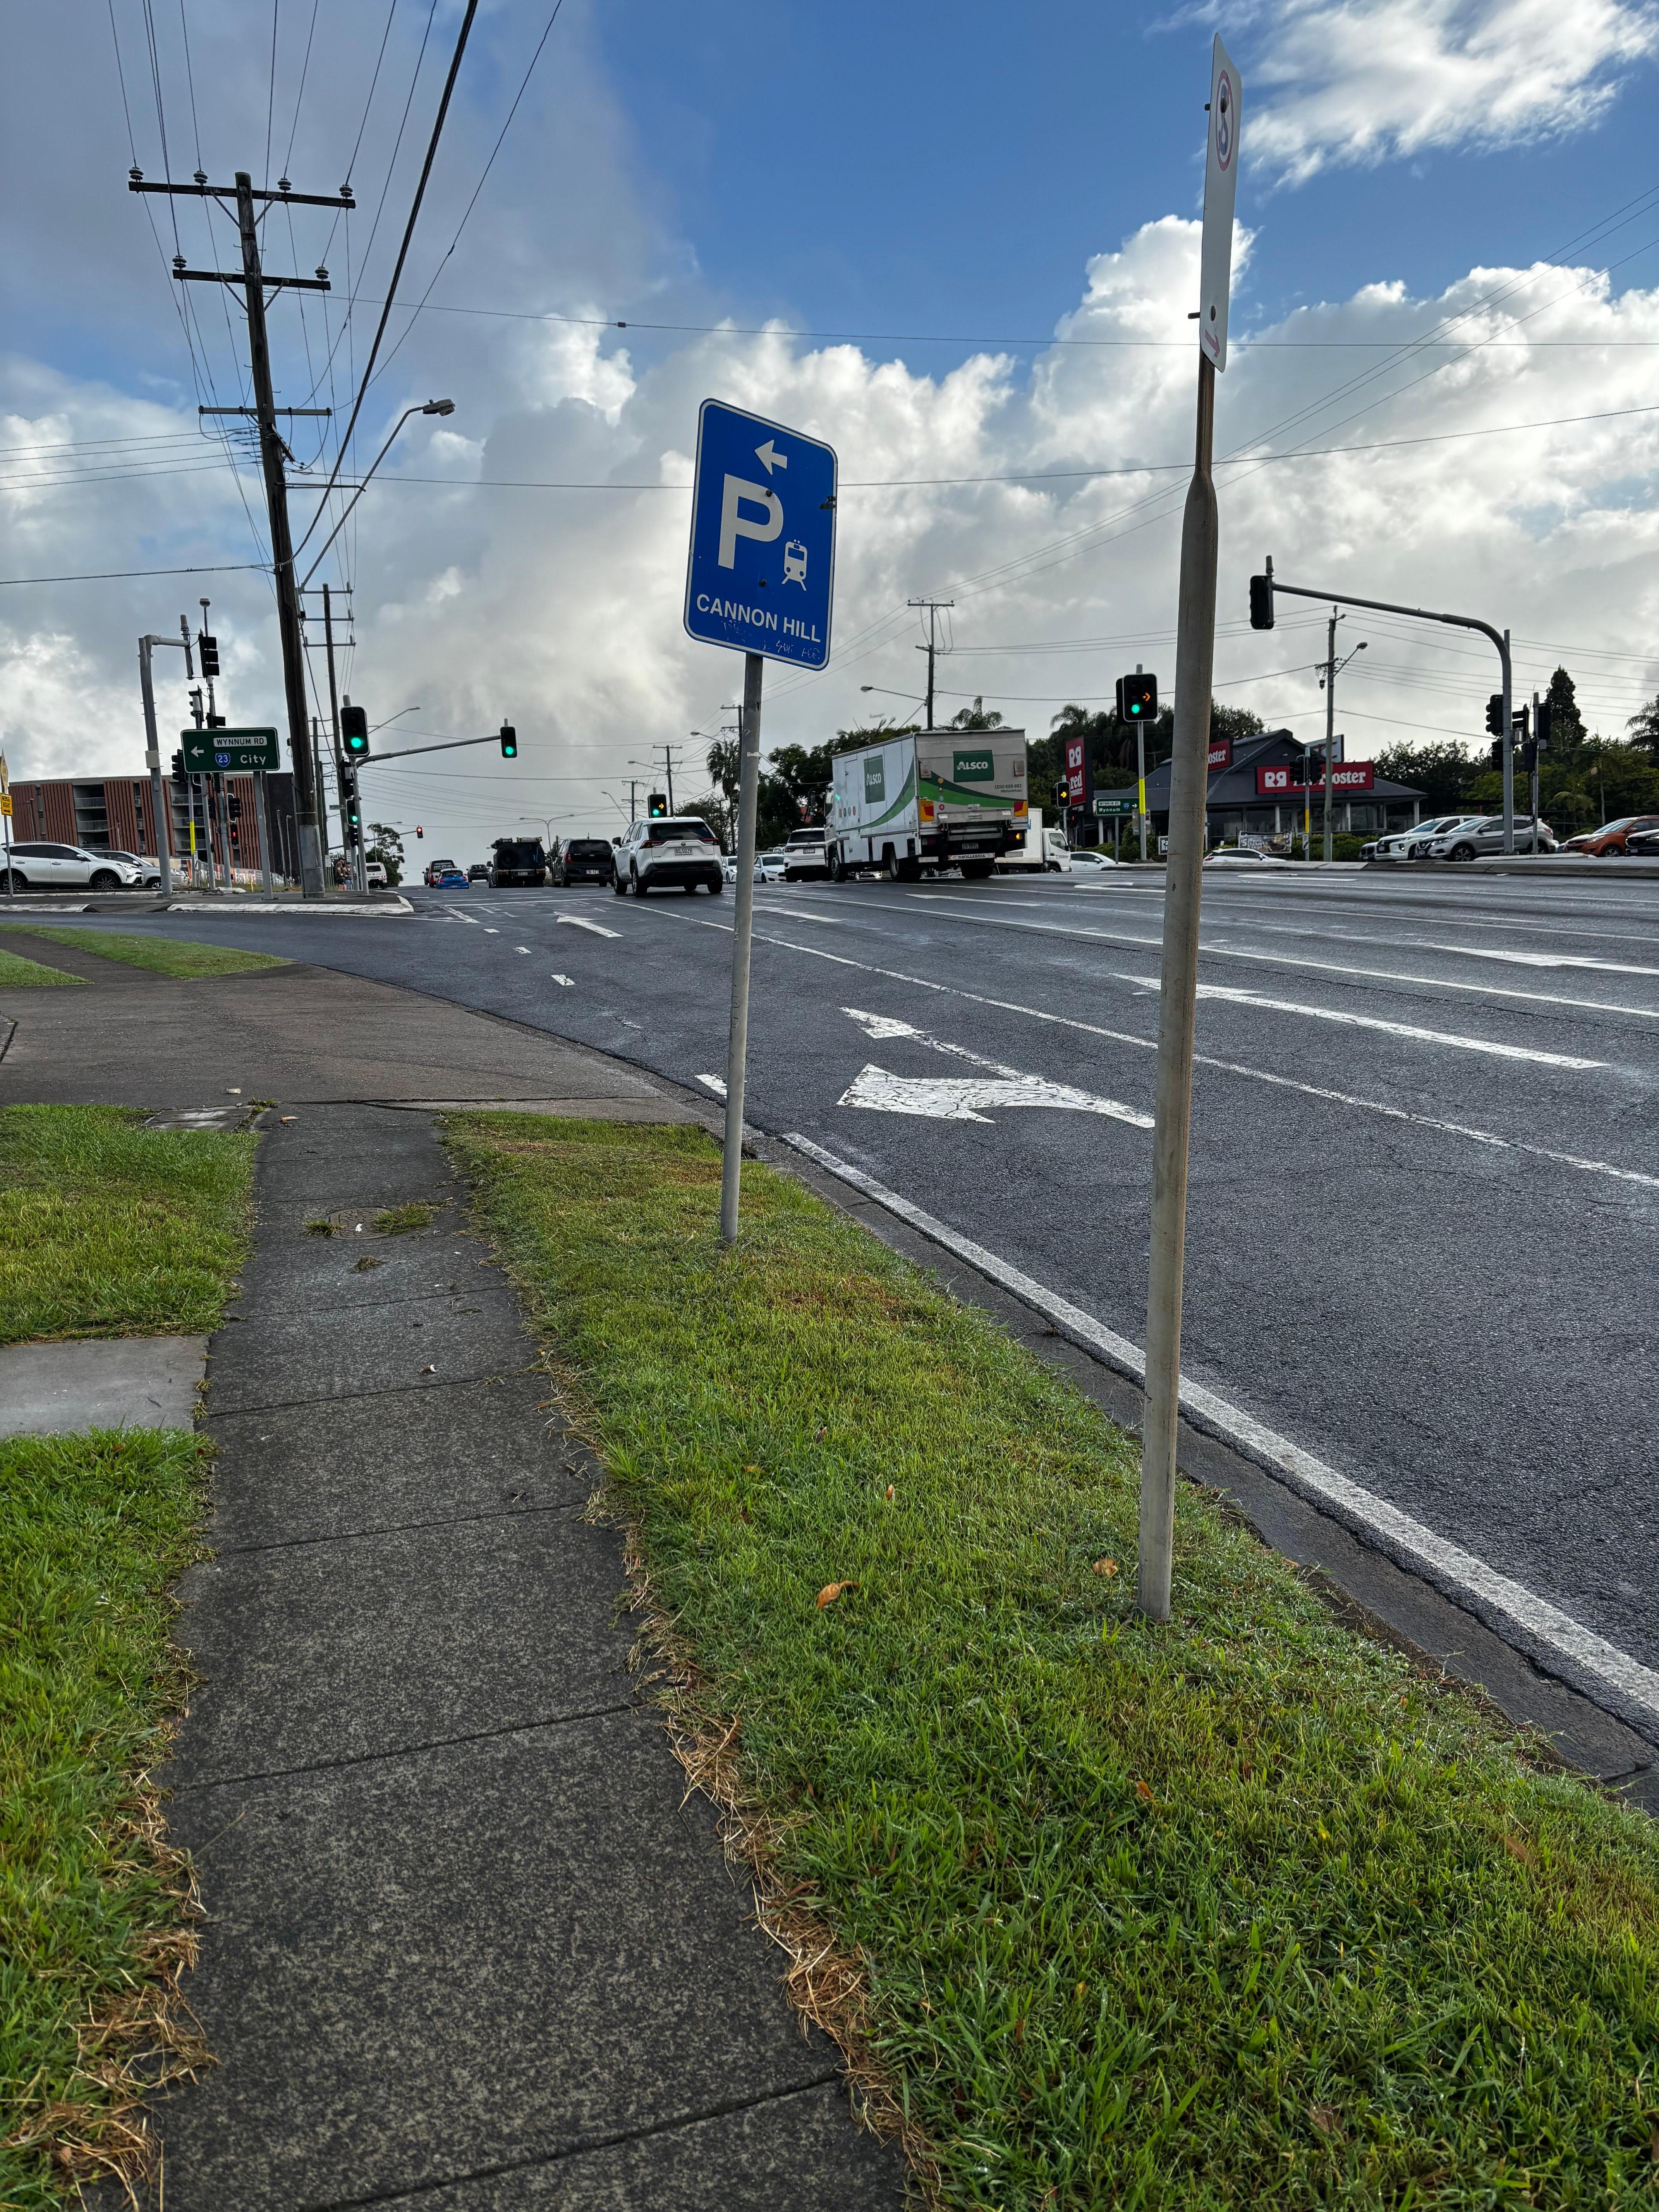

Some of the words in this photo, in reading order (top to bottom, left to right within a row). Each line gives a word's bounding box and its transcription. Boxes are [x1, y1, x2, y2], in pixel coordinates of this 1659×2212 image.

[718, 473, 783, 569] P
[697, 594, 777, 630] CANNON
[783, 617, 821, 642] HILL
[218, 755, 228, 763] 23
[240, 754, 266, 765] City
[1208, 750, 1226, 764] oster
[956, 761, 988, 770] ALSCO
[1070, 770, 1083, 789] red
[1319, 771, 1366, 785] roster
